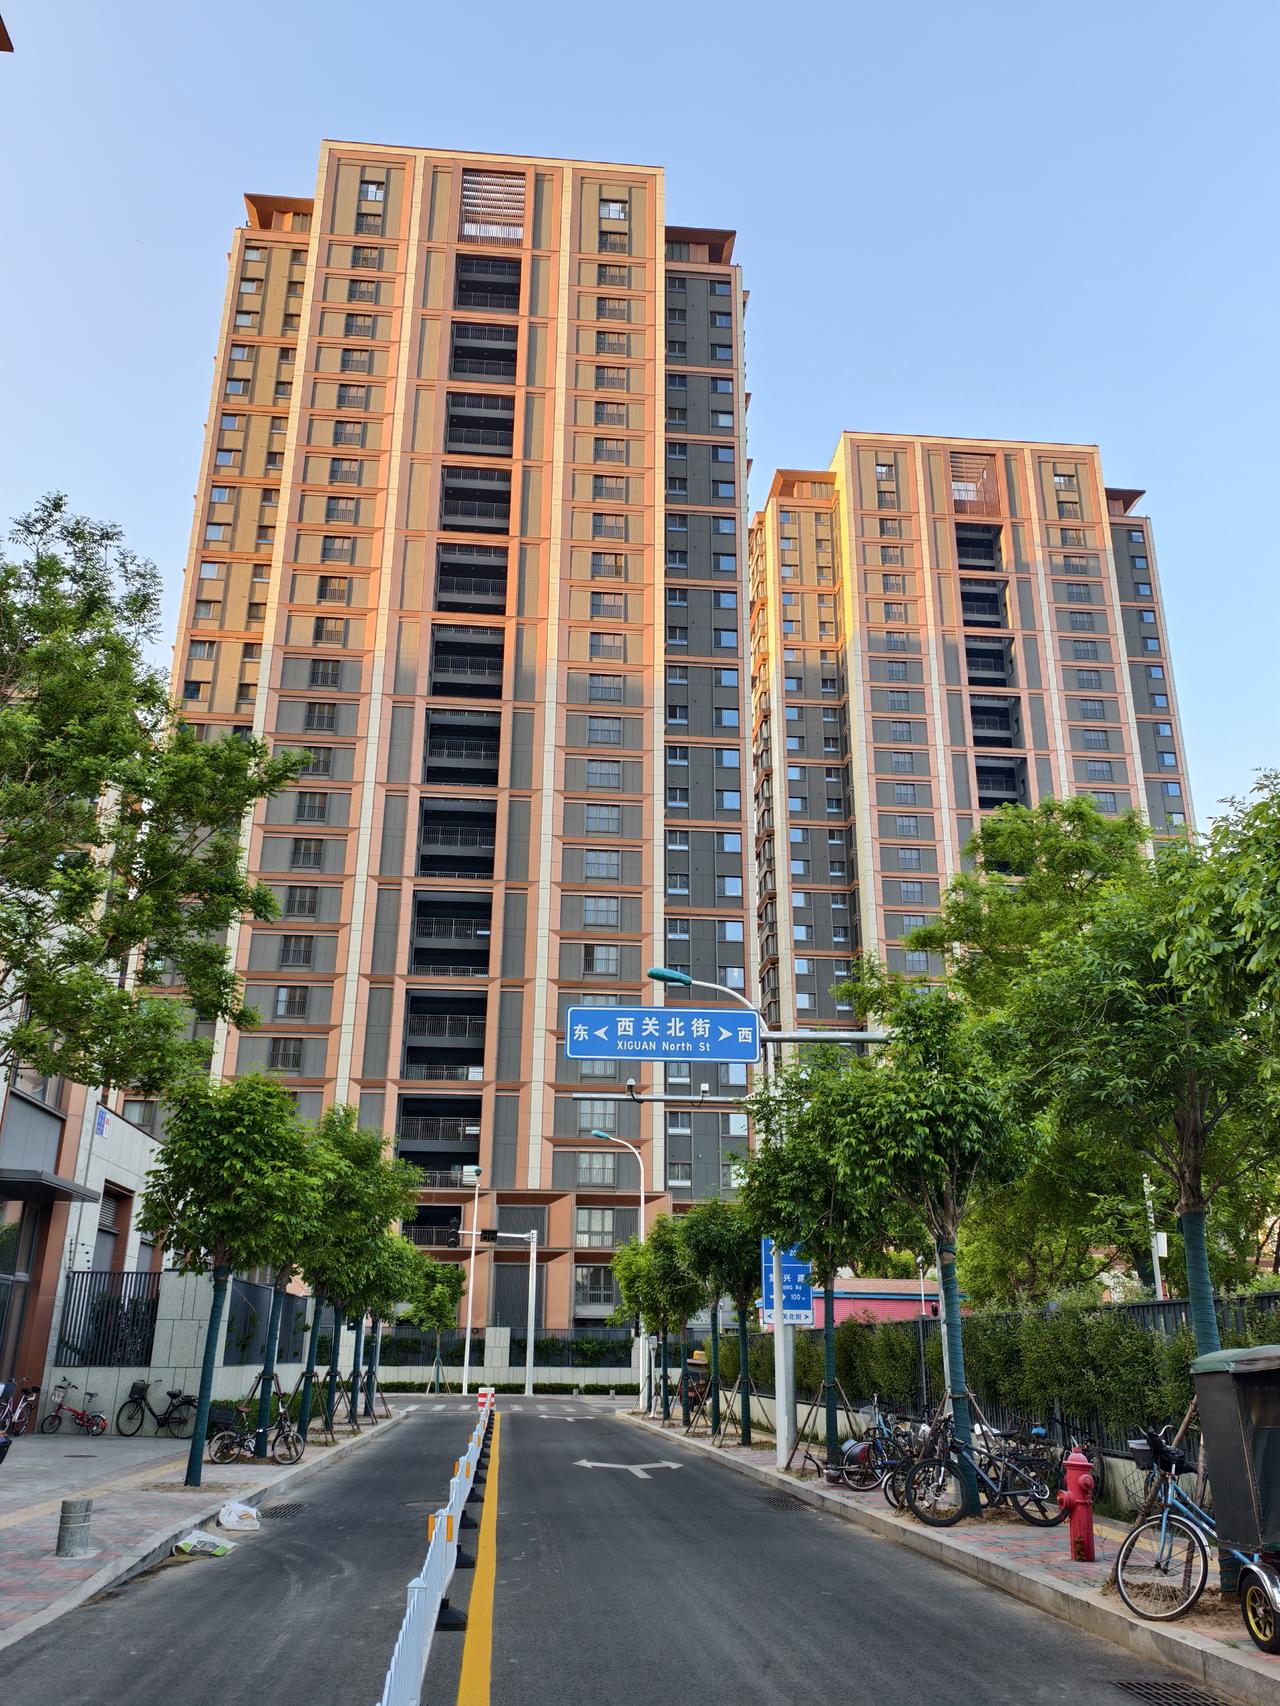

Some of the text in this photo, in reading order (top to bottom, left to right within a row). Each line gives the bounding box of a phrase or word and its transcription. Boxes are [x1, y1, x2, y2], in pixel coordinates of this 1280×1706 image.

[573, 1023, 589, 1041] 东
[616, 1016, 711, 1038] 西关北街
[737, 1027, 753, 1043] 西
[616, 1040, 711, 1052] XIGUAN North St
[790, 1293, 801, 1301] 100
